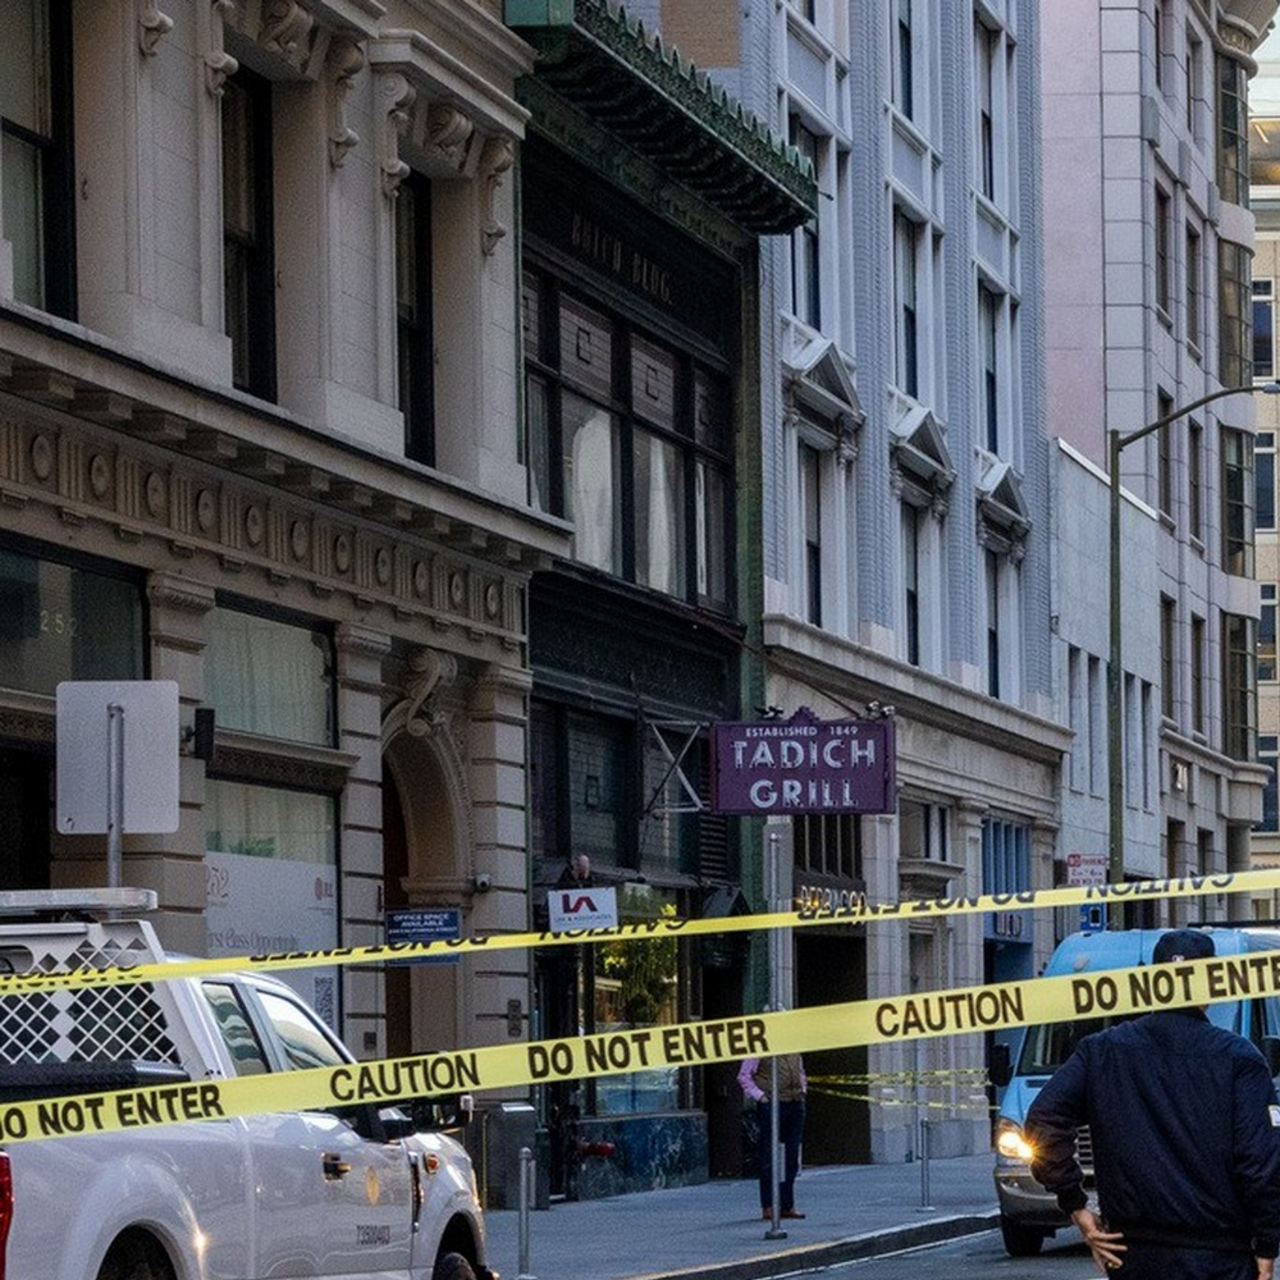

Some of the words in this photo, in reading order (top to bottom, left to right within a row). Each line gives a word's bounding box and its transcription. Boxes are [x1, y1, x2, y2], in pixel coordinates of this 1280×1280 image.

[731, 739, 876, 769] TADICH
[746, 726, 817, 737] ESTABLISHED
[830, 726, 858, 735] 1849
[750, 778, 858, 809] GRILL
[876, 987, 1024, 1036] CAUTION
[1072, 977, 1118, 1014] DO
[1129, 965, 1194, 1007] NOT
[528, 1043, 573, 1079] DO
[585, 1032, 650, 1072] NOT
[662, 1018, 769, 1064] ENTER
[330, 1053, 481, 1102] CAUTION
[38, 1100, 105, 1136] NOT
[115, 1084, 225, 1127] ENTER
